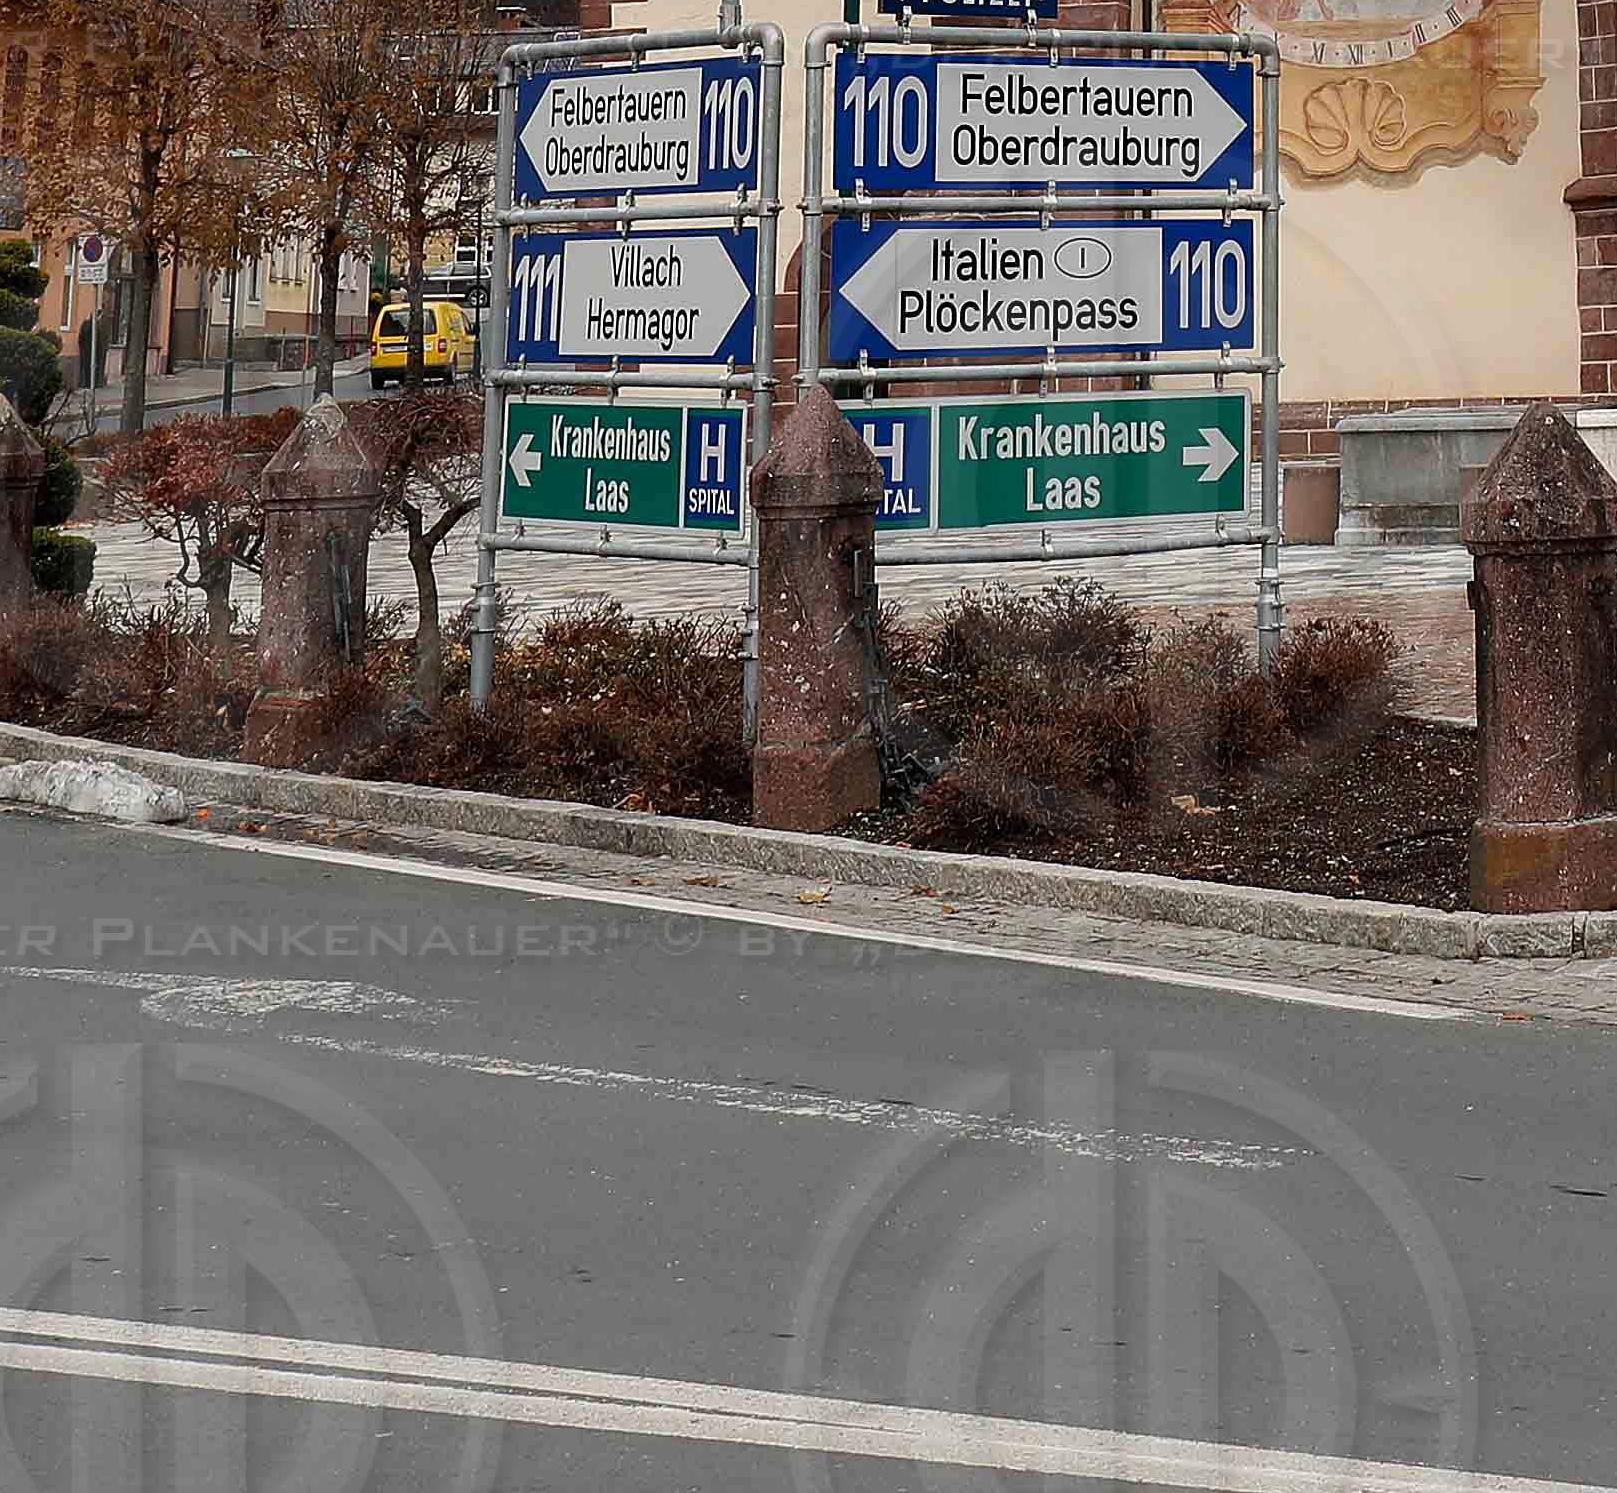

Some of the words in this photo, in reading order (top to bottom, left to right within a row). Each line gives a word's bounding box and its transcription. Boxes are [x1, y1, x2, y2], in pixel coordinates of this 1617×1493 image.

[552, 86, 686, 127] Felbertauern
[961, 73, 1193, 117] Felbertauern
[704, 77, 756, 170] 110
[843, 75, 928, 168] 110
[546, 133, 689, 180] Oberdrauburg
[953, 124, 1200, 176] Oberdrauburg
[611, 245, 681, 287] Villach
[931, 237, 1043, 281] Italien
[1170, 239, 1245, 329] 110
[514, 254, 561, 342] 111
[899, 289, 1138, 341] Plöckenpass
[587, 298, 699, 351] Hermagor
[551, 415, 670, 462] Krankenhaus
[700, 424, 726, 483] H
[863, 423, 904, 482] H
[959, 411, 1166, 461] Krankenhaus
[585, 468, 629, 513] Laas
[689, 489, 735, 515] SPITAL
[1026, 467, 1102, 512] Laas
